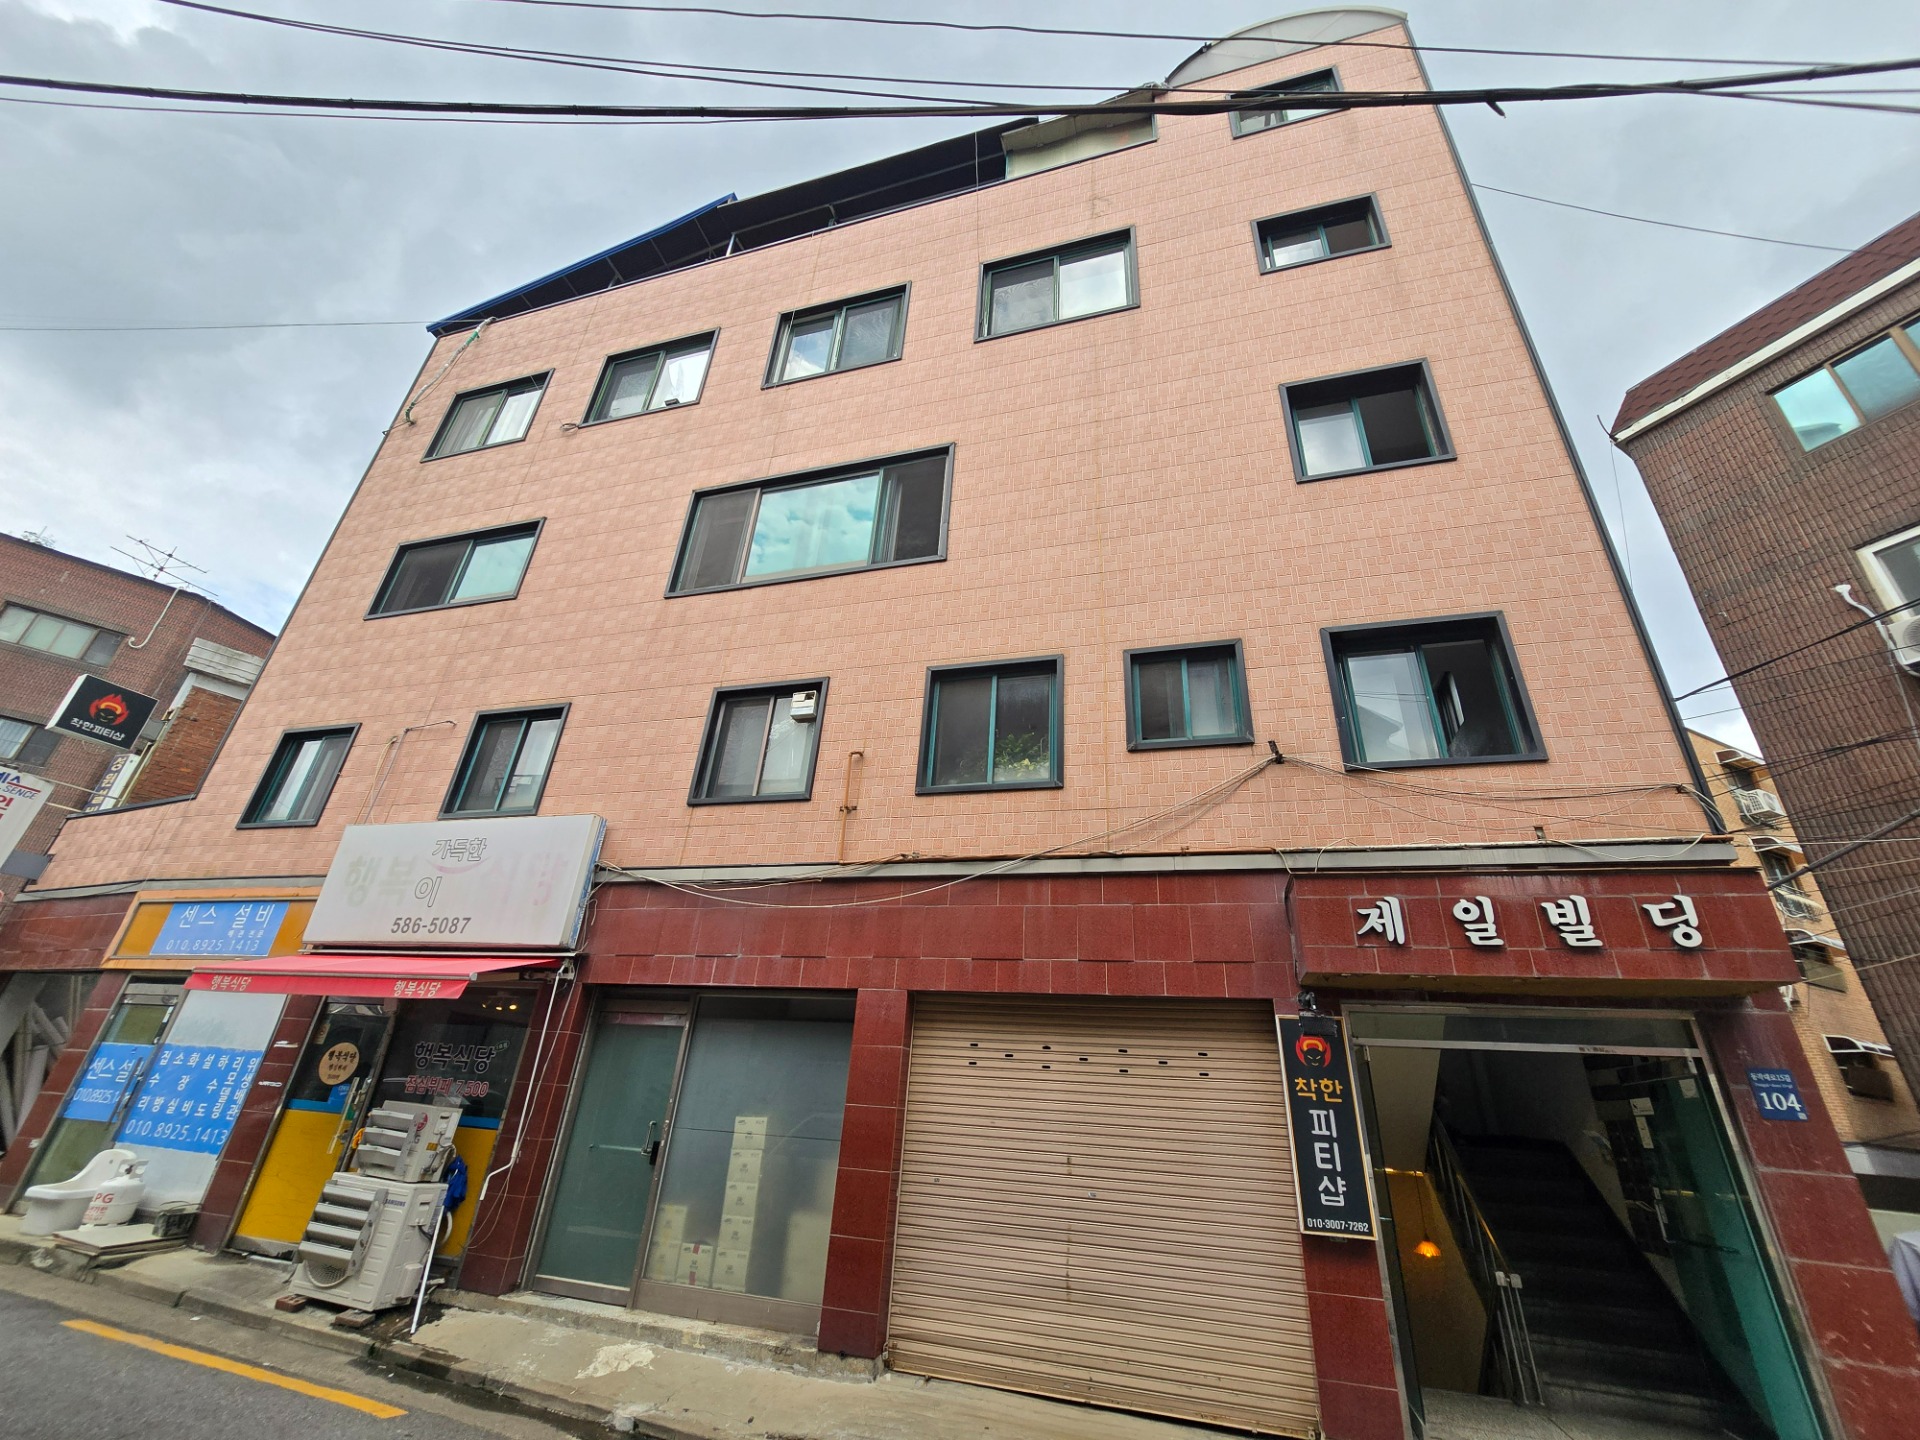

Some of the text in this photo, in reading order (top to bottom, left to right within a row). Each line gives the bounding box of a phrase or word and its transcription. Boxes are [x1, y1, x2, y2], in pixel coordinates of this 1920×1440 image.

[432, 837, 487, 862] 가득한
[179, 903, 276, 929] 센스 설비
[390, 917, 471, 934] 586-5087
[166, 939, 260, 952] 010.8925.1413
[211, 975, 251, 992] 행복식당
[393, 980, 441, 998] 행복식당
[415, 1041, 497, 1074] 행복식당
[404, 1074, 453, 1097] 점심뷔페
[1295, 1077, 1343, 1102] 착한
[1759, 1092, 1802, 1111] 104
[1308, 1109, 1347, 1207] 피티샵
